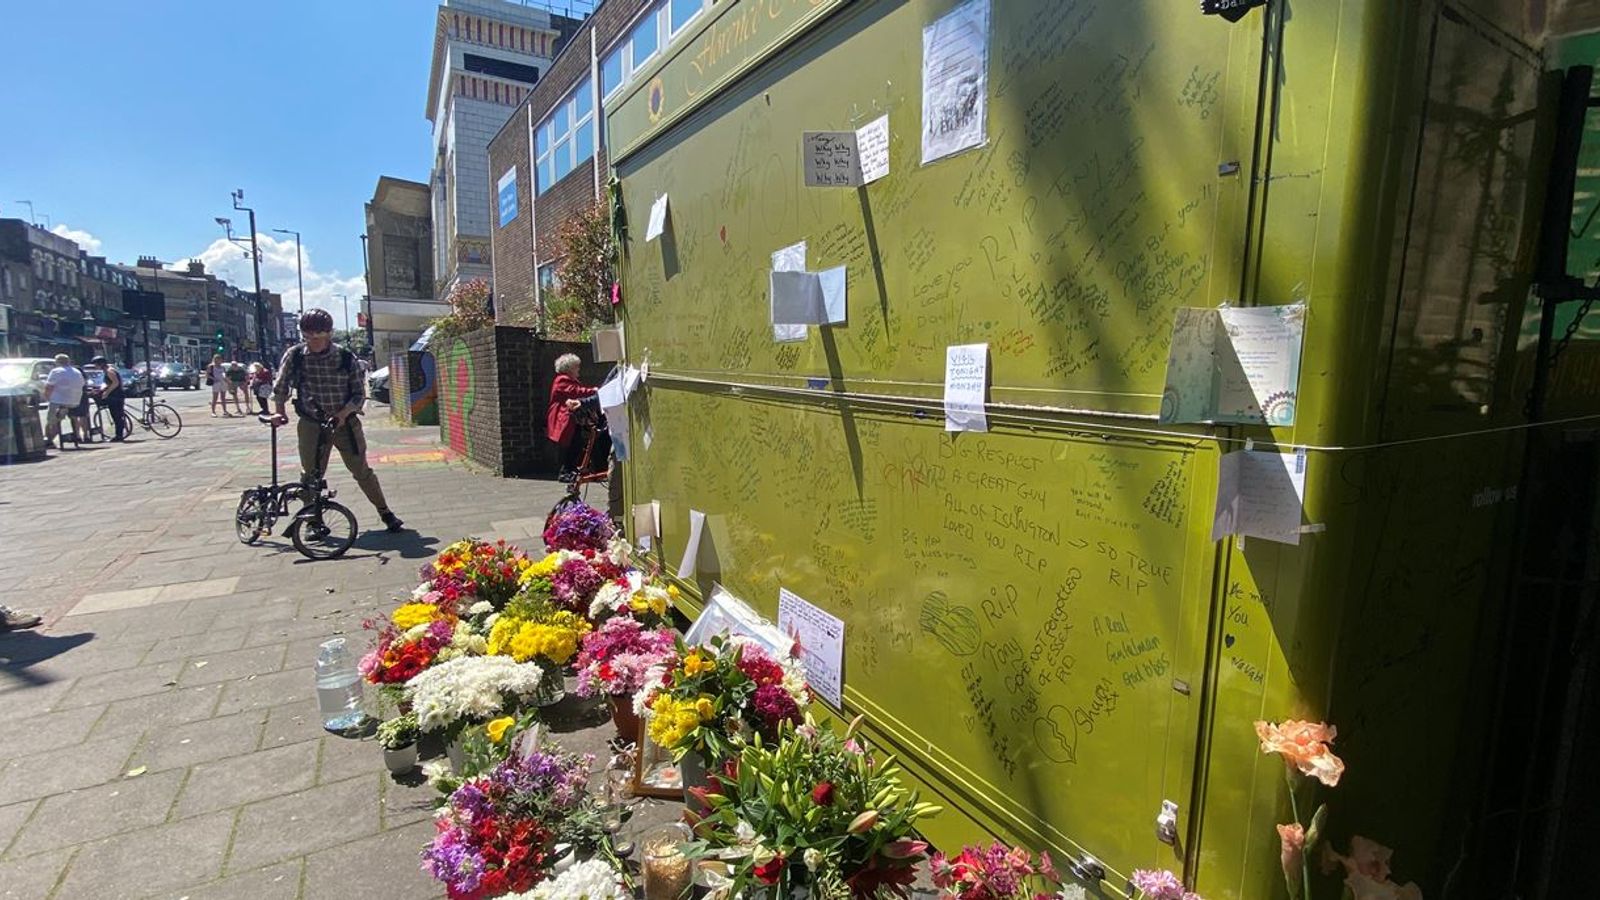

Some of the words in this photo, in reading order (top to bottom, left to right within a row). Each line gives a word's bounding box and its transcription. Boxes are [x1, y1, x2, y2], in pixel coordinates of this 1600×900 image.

[944, 492, 968, 515] ALL
[967, 472, 1017, 493] GREAT
[1017, 482, 1047, 511] GUY
[1013, 544, 1048, 574] RIP
